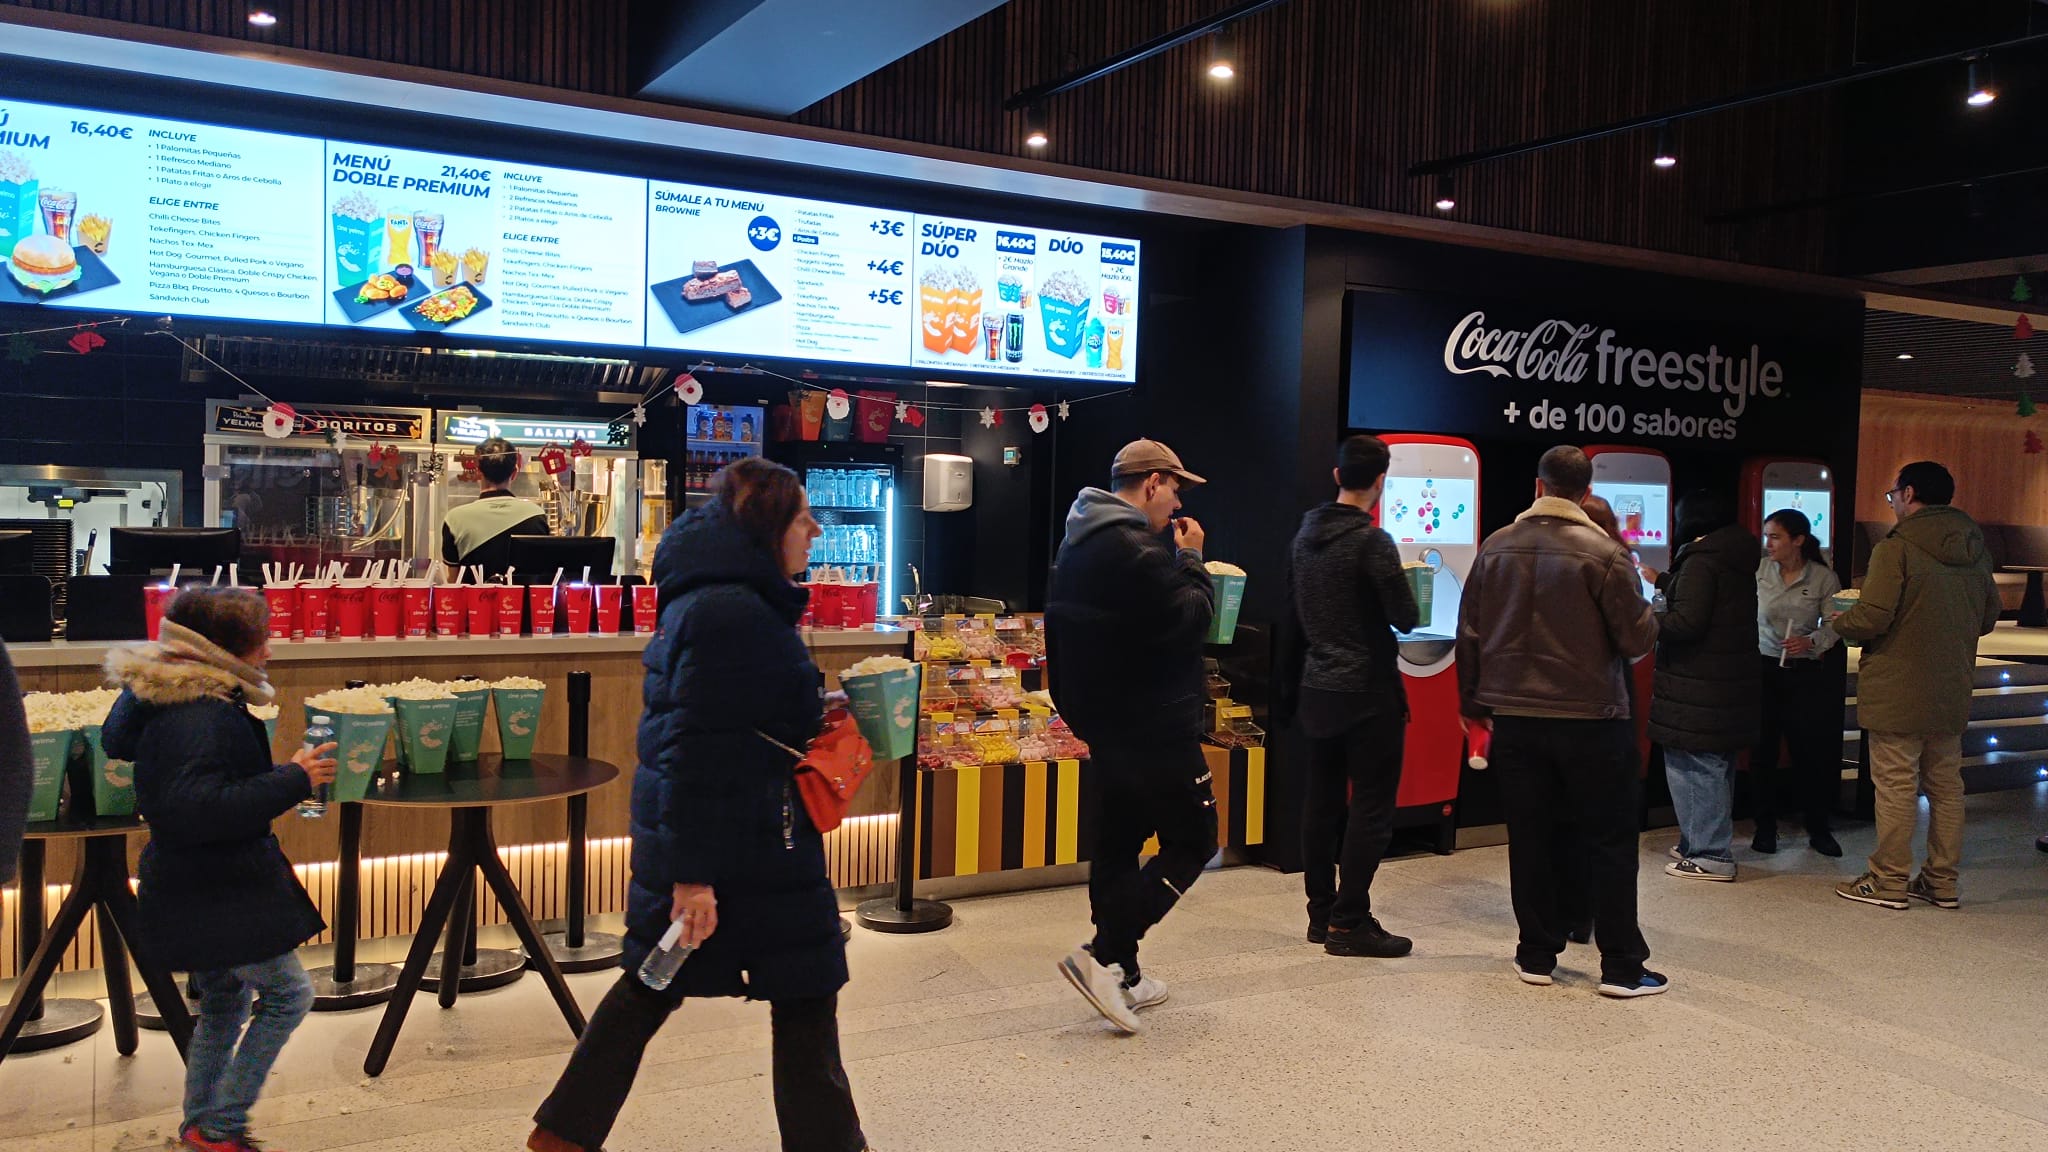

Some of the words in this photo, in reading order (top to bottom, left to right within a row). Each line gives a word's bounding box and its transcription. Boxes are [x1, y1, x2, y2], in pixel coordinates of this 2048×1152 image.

[70, 121, 134, 139] 16,40€
[148, 129, 197, 142] INCLUYE
[161, 144, 201, 154] Palomitas
[202, 148, 241, 159] Pequeñas
[161, 155, 196, 164] Refresco
[197, 160, 232, 168] Mediano
[332, 152, 391, 172] MENÚ
[161, 166, 191, 175] Patatas
[193, 170, 214, 178] Fritas
[253, 176, 282, 185] Cebolla
[440, 165, 491, 182] 21,40€
[504, 172, 543, 183] INCLUYE
[162, 177, 182, 186] Plato
[190, 181, 211, 189] elegir
[332, 169, 399, 189] DOBLE
[403, 178, 490, 199] PREMIUM
[149, 197, 181, 206] ELIGE
[184, 200, 220, 210] ENTRE
[655, 189, 702, 205] SÚMALE
[703, 196, 712, 206] A
[715, 198, 729, 208] TU
[731, 200, 765, 212] MENÚ
[655, 205, 700, 216] BROWNIE
[171, 215, 199, 223] Cheese
[749, 227, 780, 241] +3€
[870, 220, 905, 237] +3€
[921, 221, 977, 243] SÚPER
[150, 237, 179, 245] Nachos
[199, 230, 230, 238] Chicken
[232, 233, 260, 242] Fingers
[503, 233, 528, 241] ELIGE
[530, 235, 560, 244] ENTRE
[921, 240, 959, 258] DÚO
[1049, 237, 1083, 254] DÚO
[150, 261, 206, 271] Hamburguesa
[262, 271, 285, 280] Crispy
[275, 260, 304, 268] Vegano
[867, 259, 904, 276] +4€
[150, 269, 180, 277] Vegana
[188, 272, 211, 280] Doble
[213, 275, 250, 283] Premium
[149, 294, 189, 302] Sandwich
[191, 296, 210, 304] Club
[241, 288, 269, 296] Quesos
[277, 292, 310, 300] Bourbon
[868, 289, 904, 305] +5€
[1444, 310, 1598, 384] Coca-Cola
[1595, 329, 1784, 418] freestyle
[316, 420, 397, 432] DORITOS
[1504, 402, 1520, 424] +
[1528, 399, 1566, 430] de
[1574, 403, 1626, 434] 100
[1632, 408, 1737, 440] sabores
[524, 427, 596, 439] SALADAS
